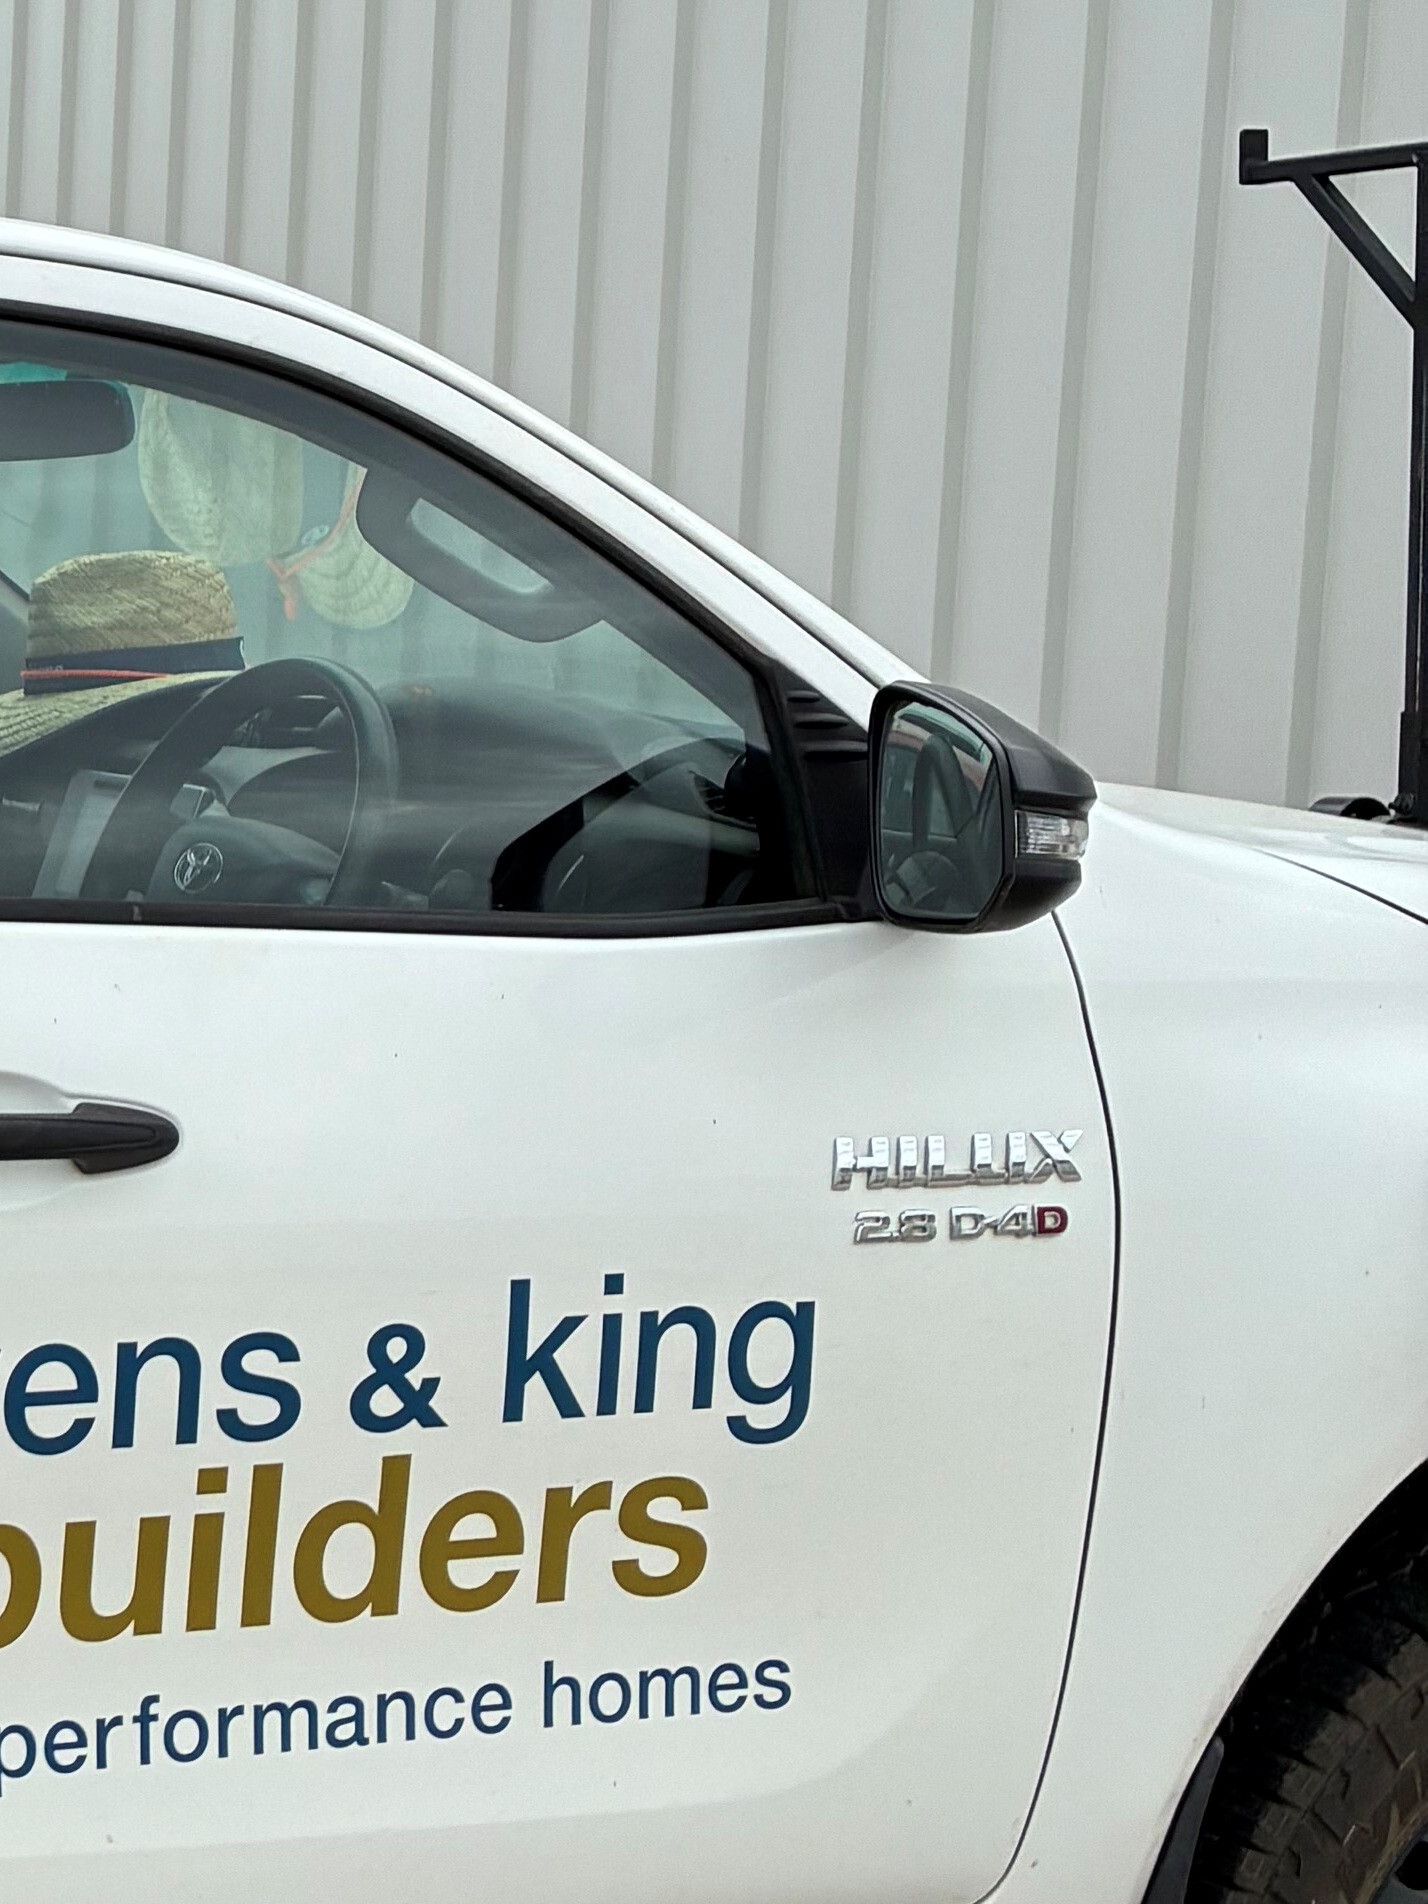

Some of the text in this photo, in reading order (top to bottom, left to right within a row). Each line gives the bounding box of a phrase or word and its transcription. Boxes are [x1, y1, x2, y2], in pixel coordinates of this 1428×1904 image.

[831, 1129, 1084, 1192] HILUX
[853, 1208, 937, 1245] 2.8
[349, 1322, 448, 1434] &
[501, 1272, 816, 1445] king
[542, 1657, 792, 1730] homes
